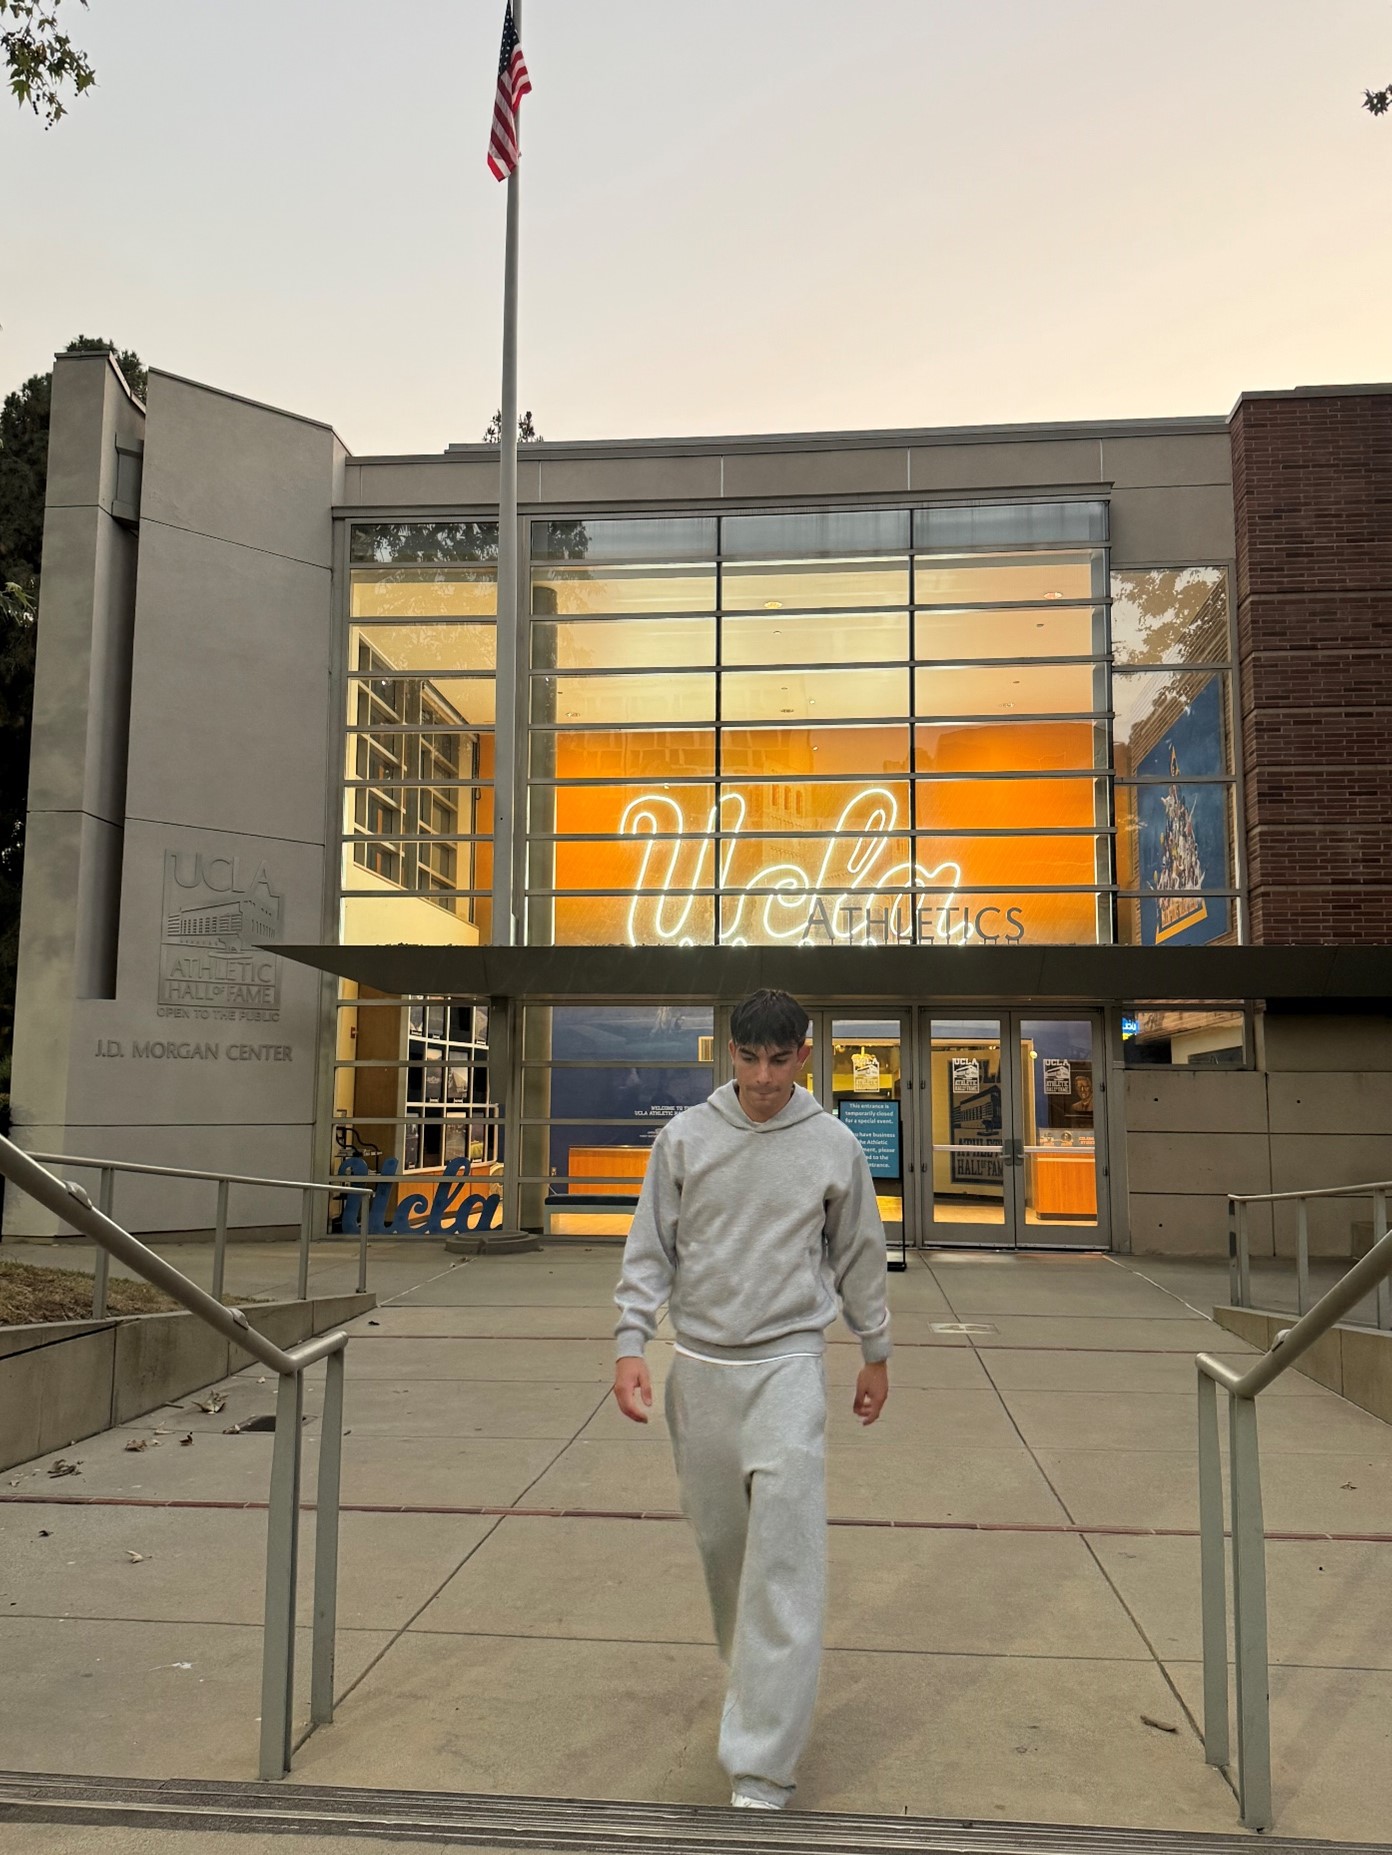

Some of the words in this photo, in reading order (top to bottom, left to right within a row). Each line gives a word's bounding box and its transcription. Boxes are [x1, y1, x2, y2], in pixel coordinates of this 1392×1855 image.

[171, 851, 279, 898] UCLA
[802, 897, 1025, 940] ATHLETICS
[170, 958, 272, 983] ATHLETIC
[168, 981, 214, 1001] HALL
[212, 986, 226, 996] OF
[227, 986, 271, 1004] FAME
[156, 1008, 190, 1019] OPEN
[193, 1010, 210, 1020] TO
[213, 1010, 236, 1021] THE
[239, 1012, 280, 1022] PUBLIC
[95, 1040, 124, 1058] J.D.
[132, 1041, 219, 1060] MORGAN
[226, 1044, 293, 1062] CENTER
[957, 1159, 982, 1175] HALL
